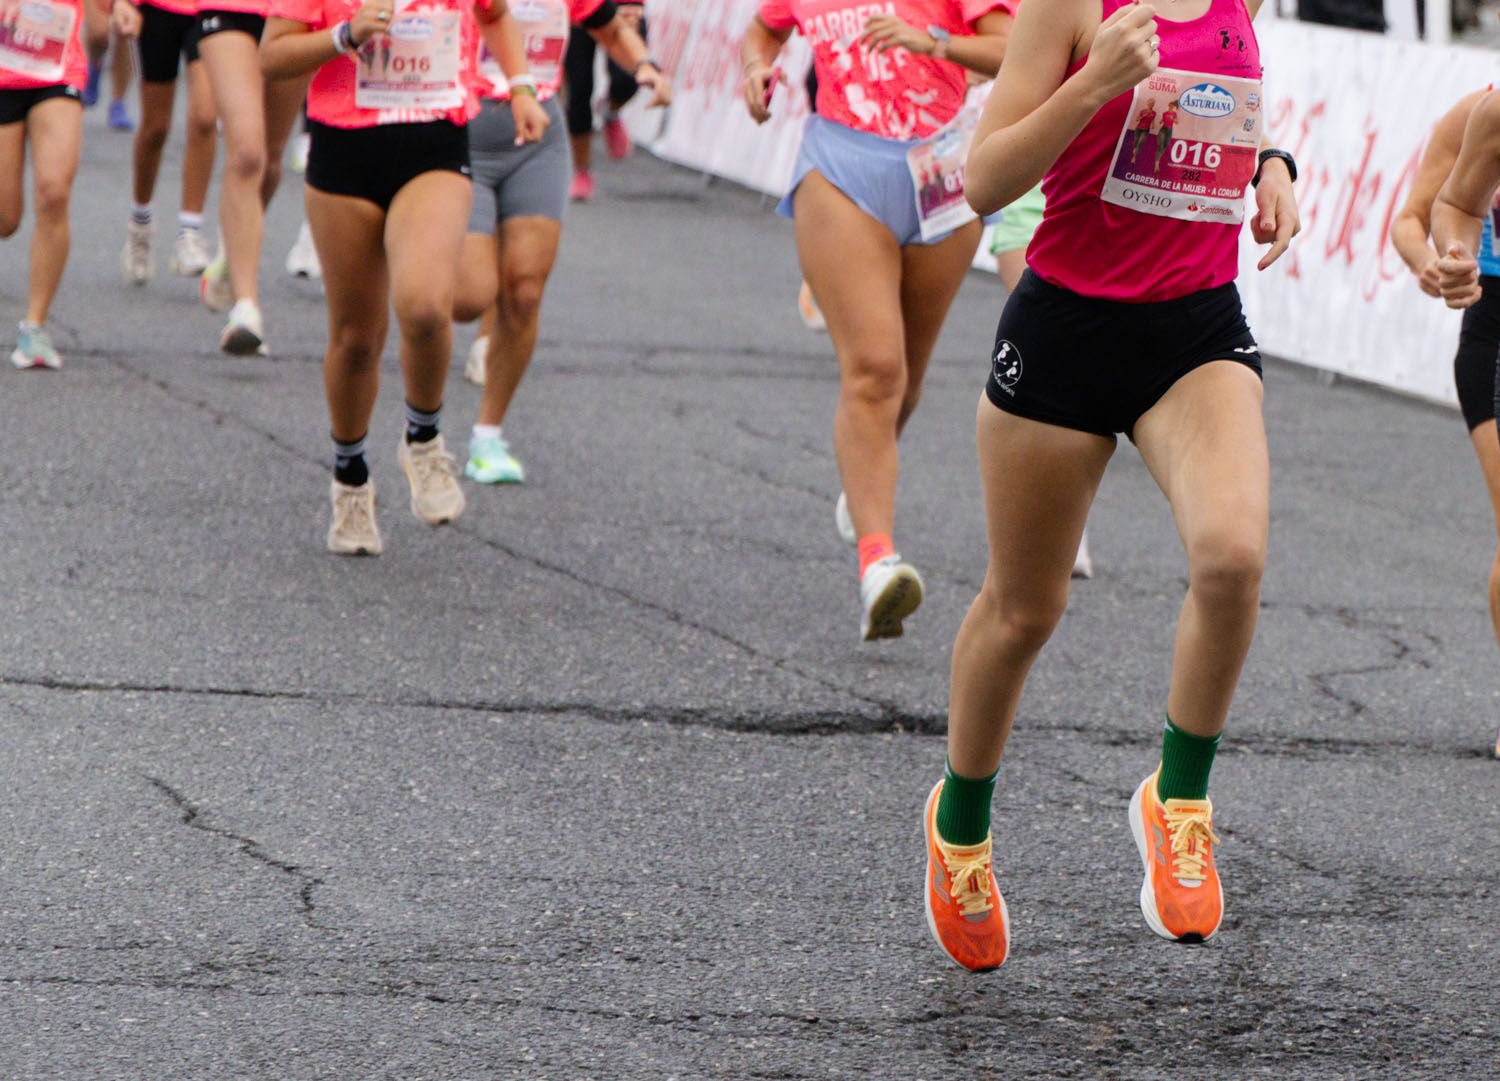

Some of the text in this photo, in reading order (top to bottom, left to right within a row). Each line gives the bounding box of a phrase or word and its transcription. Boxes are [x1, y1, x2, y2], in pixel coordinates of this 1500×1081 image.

[1149, 81, 1177, 94] SUMA
[1183, 94, 1231, 112] ASTURIANA
[1170, 139, 1222, 169] 016
[1125, 171, 1159, 188] CARRERA
[1161, 180, 1172, 190] DE
[1172, 182, 1181, 191] LA
[1183, 183, 1206, 195] MUJER
[1211, 187, 1217, 196] A
[1122, 188, 1172, 209] OYSHO
